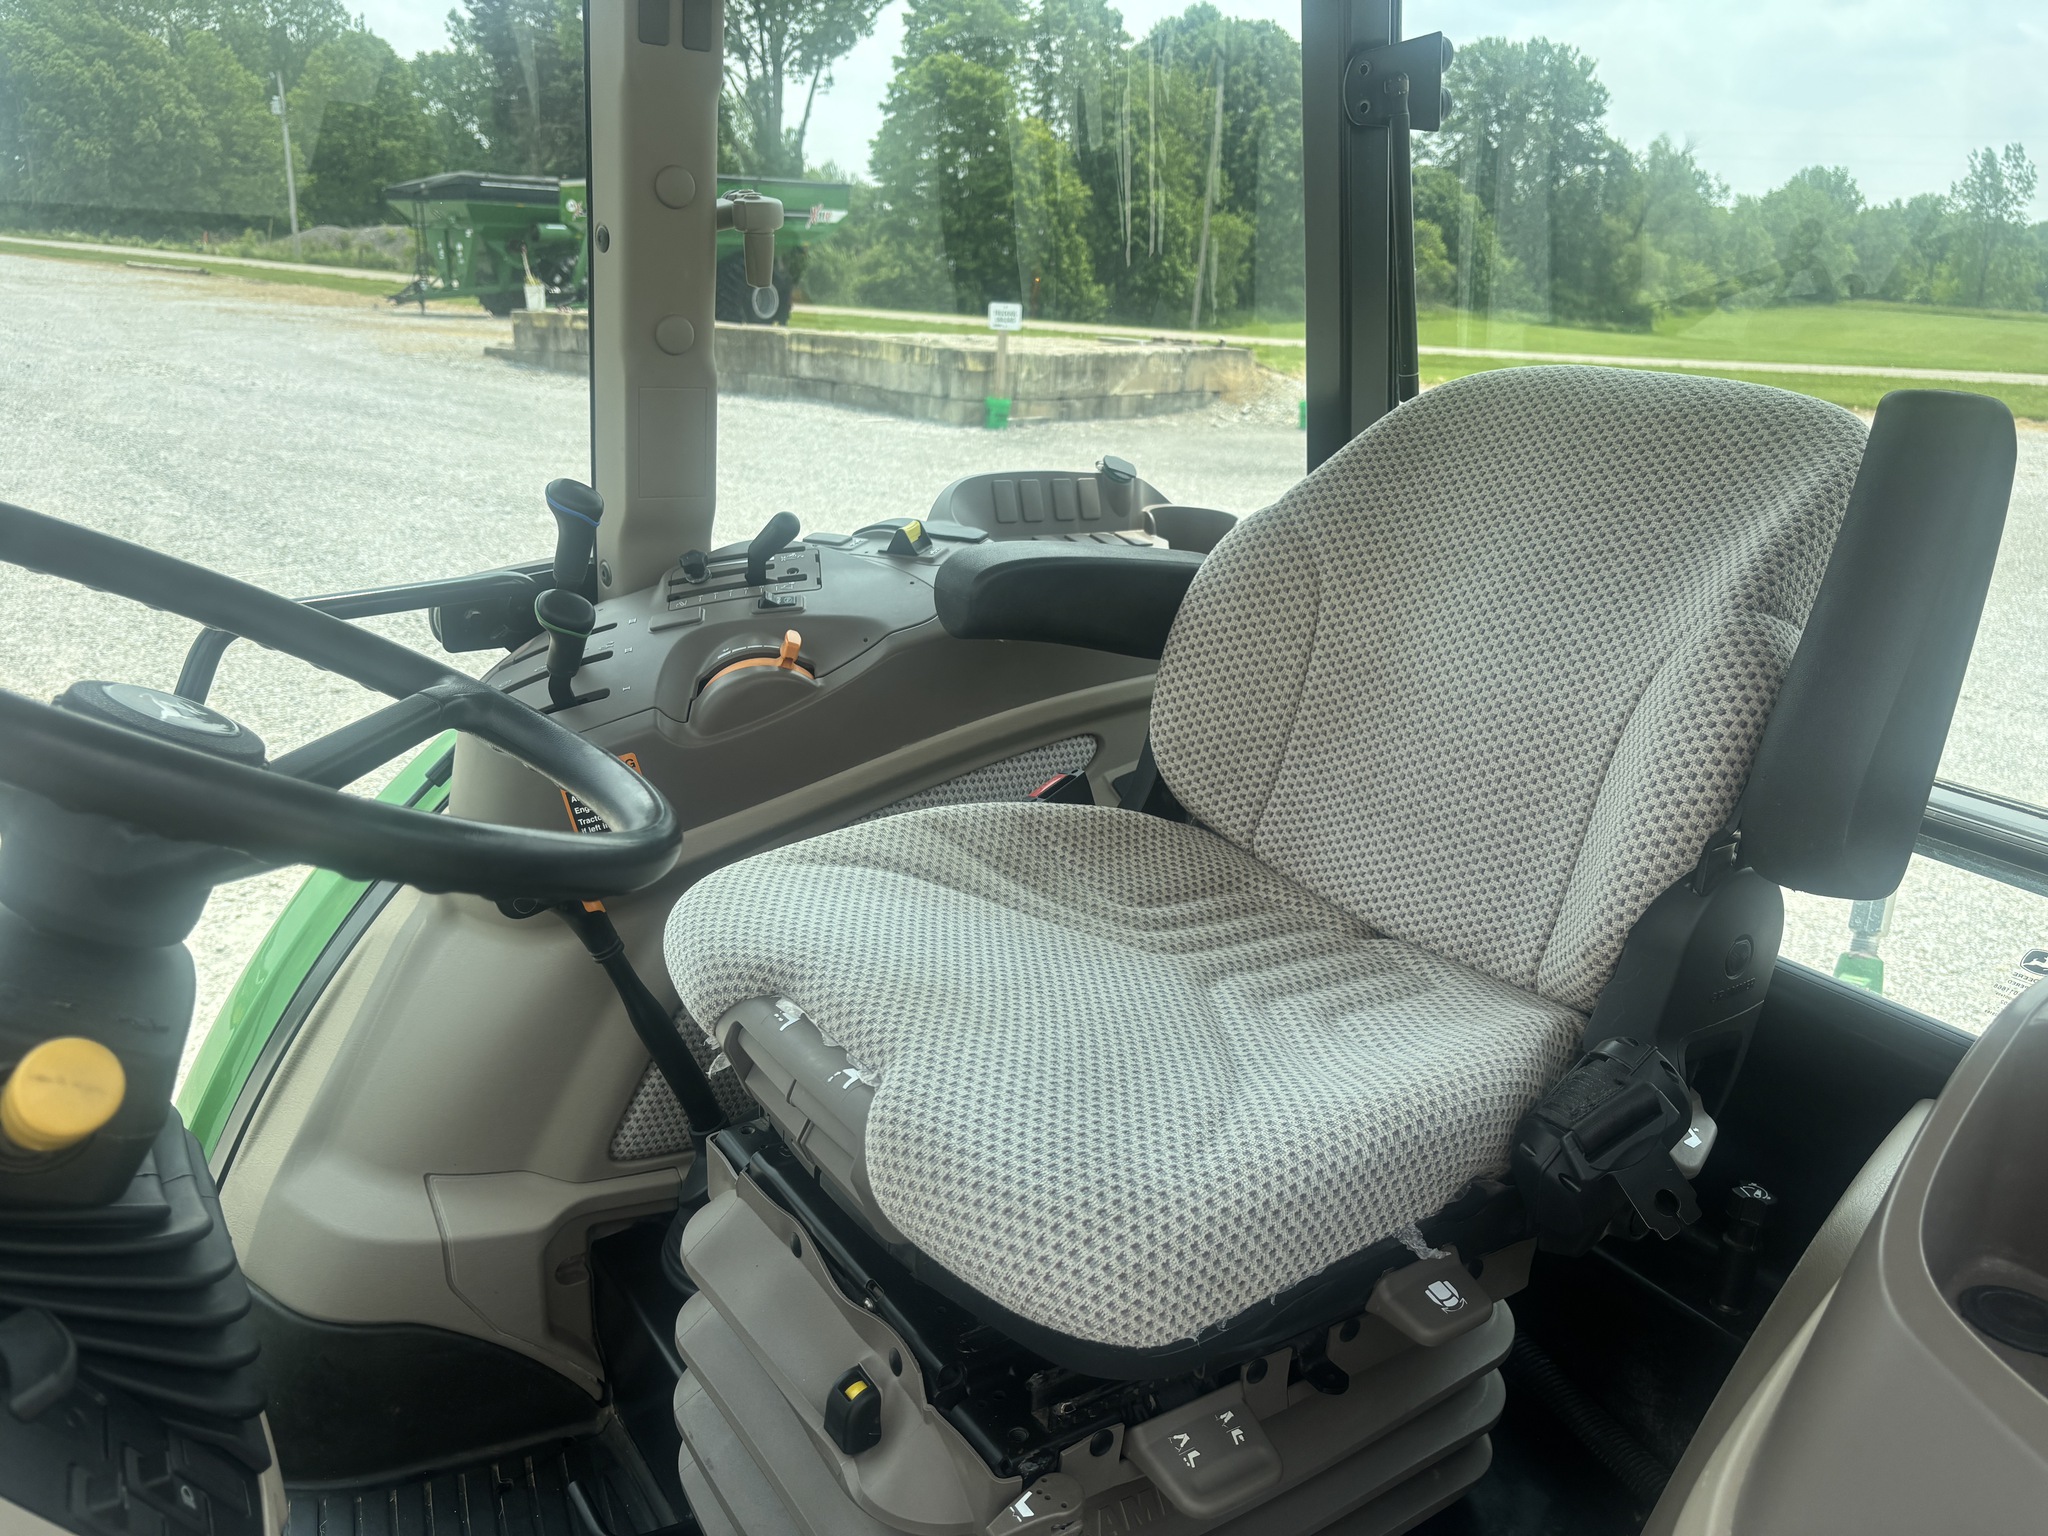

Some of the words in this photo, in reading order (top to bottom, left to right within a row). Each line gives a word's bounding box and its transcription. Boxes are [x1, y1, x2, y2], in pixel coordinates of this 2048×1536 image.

[574, 806, 592, 815] Eng
[577, 815, 602, 826] Tracto
[587, 825, 602, 833] left
